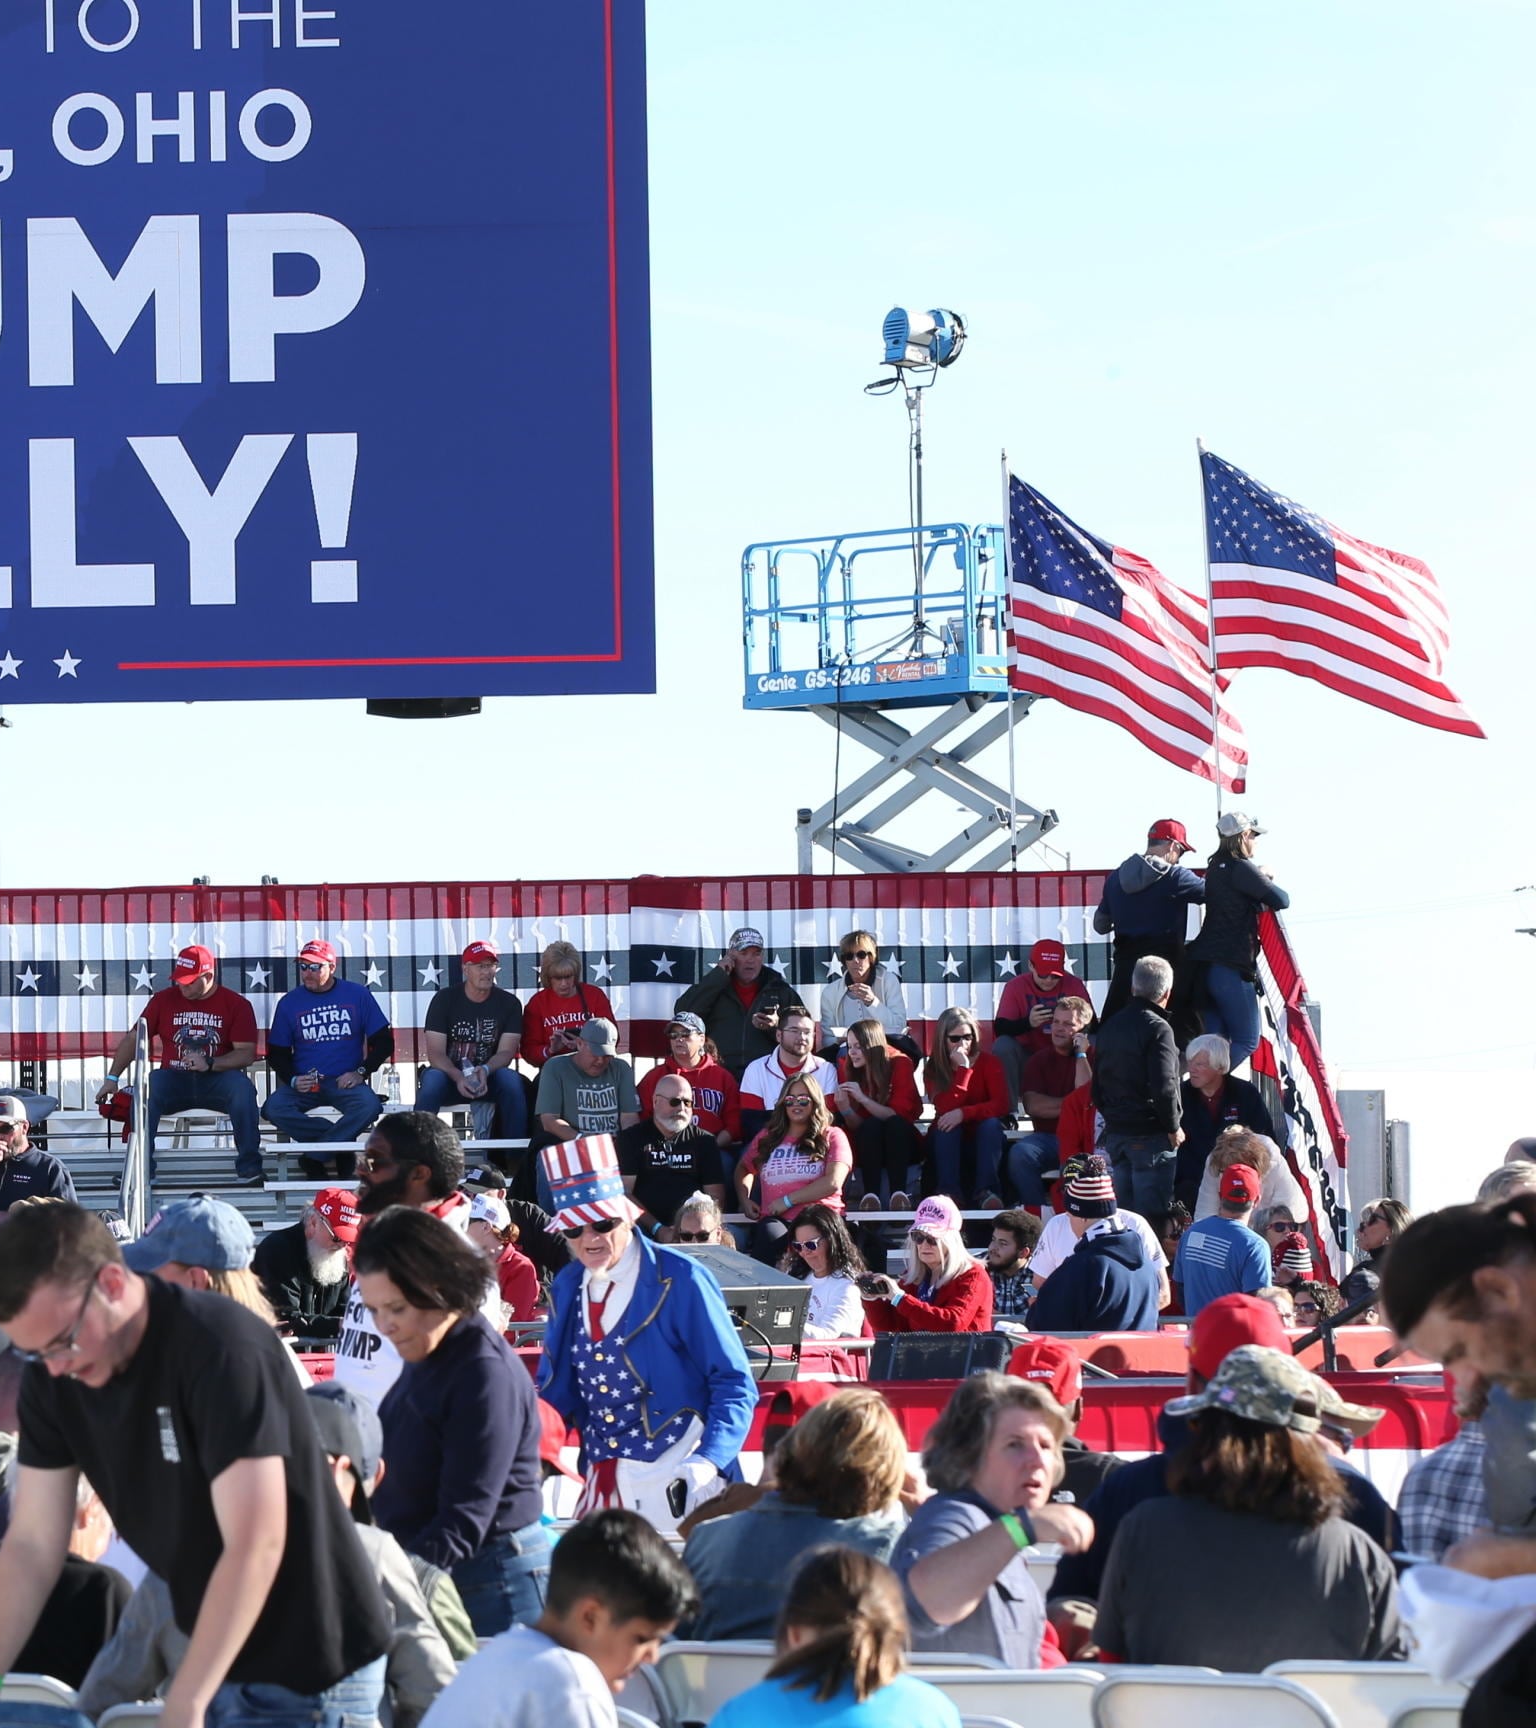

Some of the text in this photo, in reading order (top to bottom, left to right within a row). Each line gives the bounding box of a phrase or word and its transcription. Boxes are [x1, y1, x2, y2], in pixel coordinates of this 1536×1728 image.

[51, 88, 313, 167] OHIO
[758, 666, 872, 693] Genie GS-3246
[173, 1017, 223, 1029] DEPLORABLE
[300, 1009, 352, 1027] ULTRA
[543, 1010, 596, 1028] AMERIC
[302, 1022, 352, 1040] MAGA
[577, 1089, 617, 1110] AARON
[580, 1114, 617, 1132] LEWIS
[320, 1203, 333, 1216] 45
[918, 1205, 945, 1220] TRUMP
[336, 1327, 383, 1362] RUMP
[1026, 1369, 1056, 1379] TRUMP
